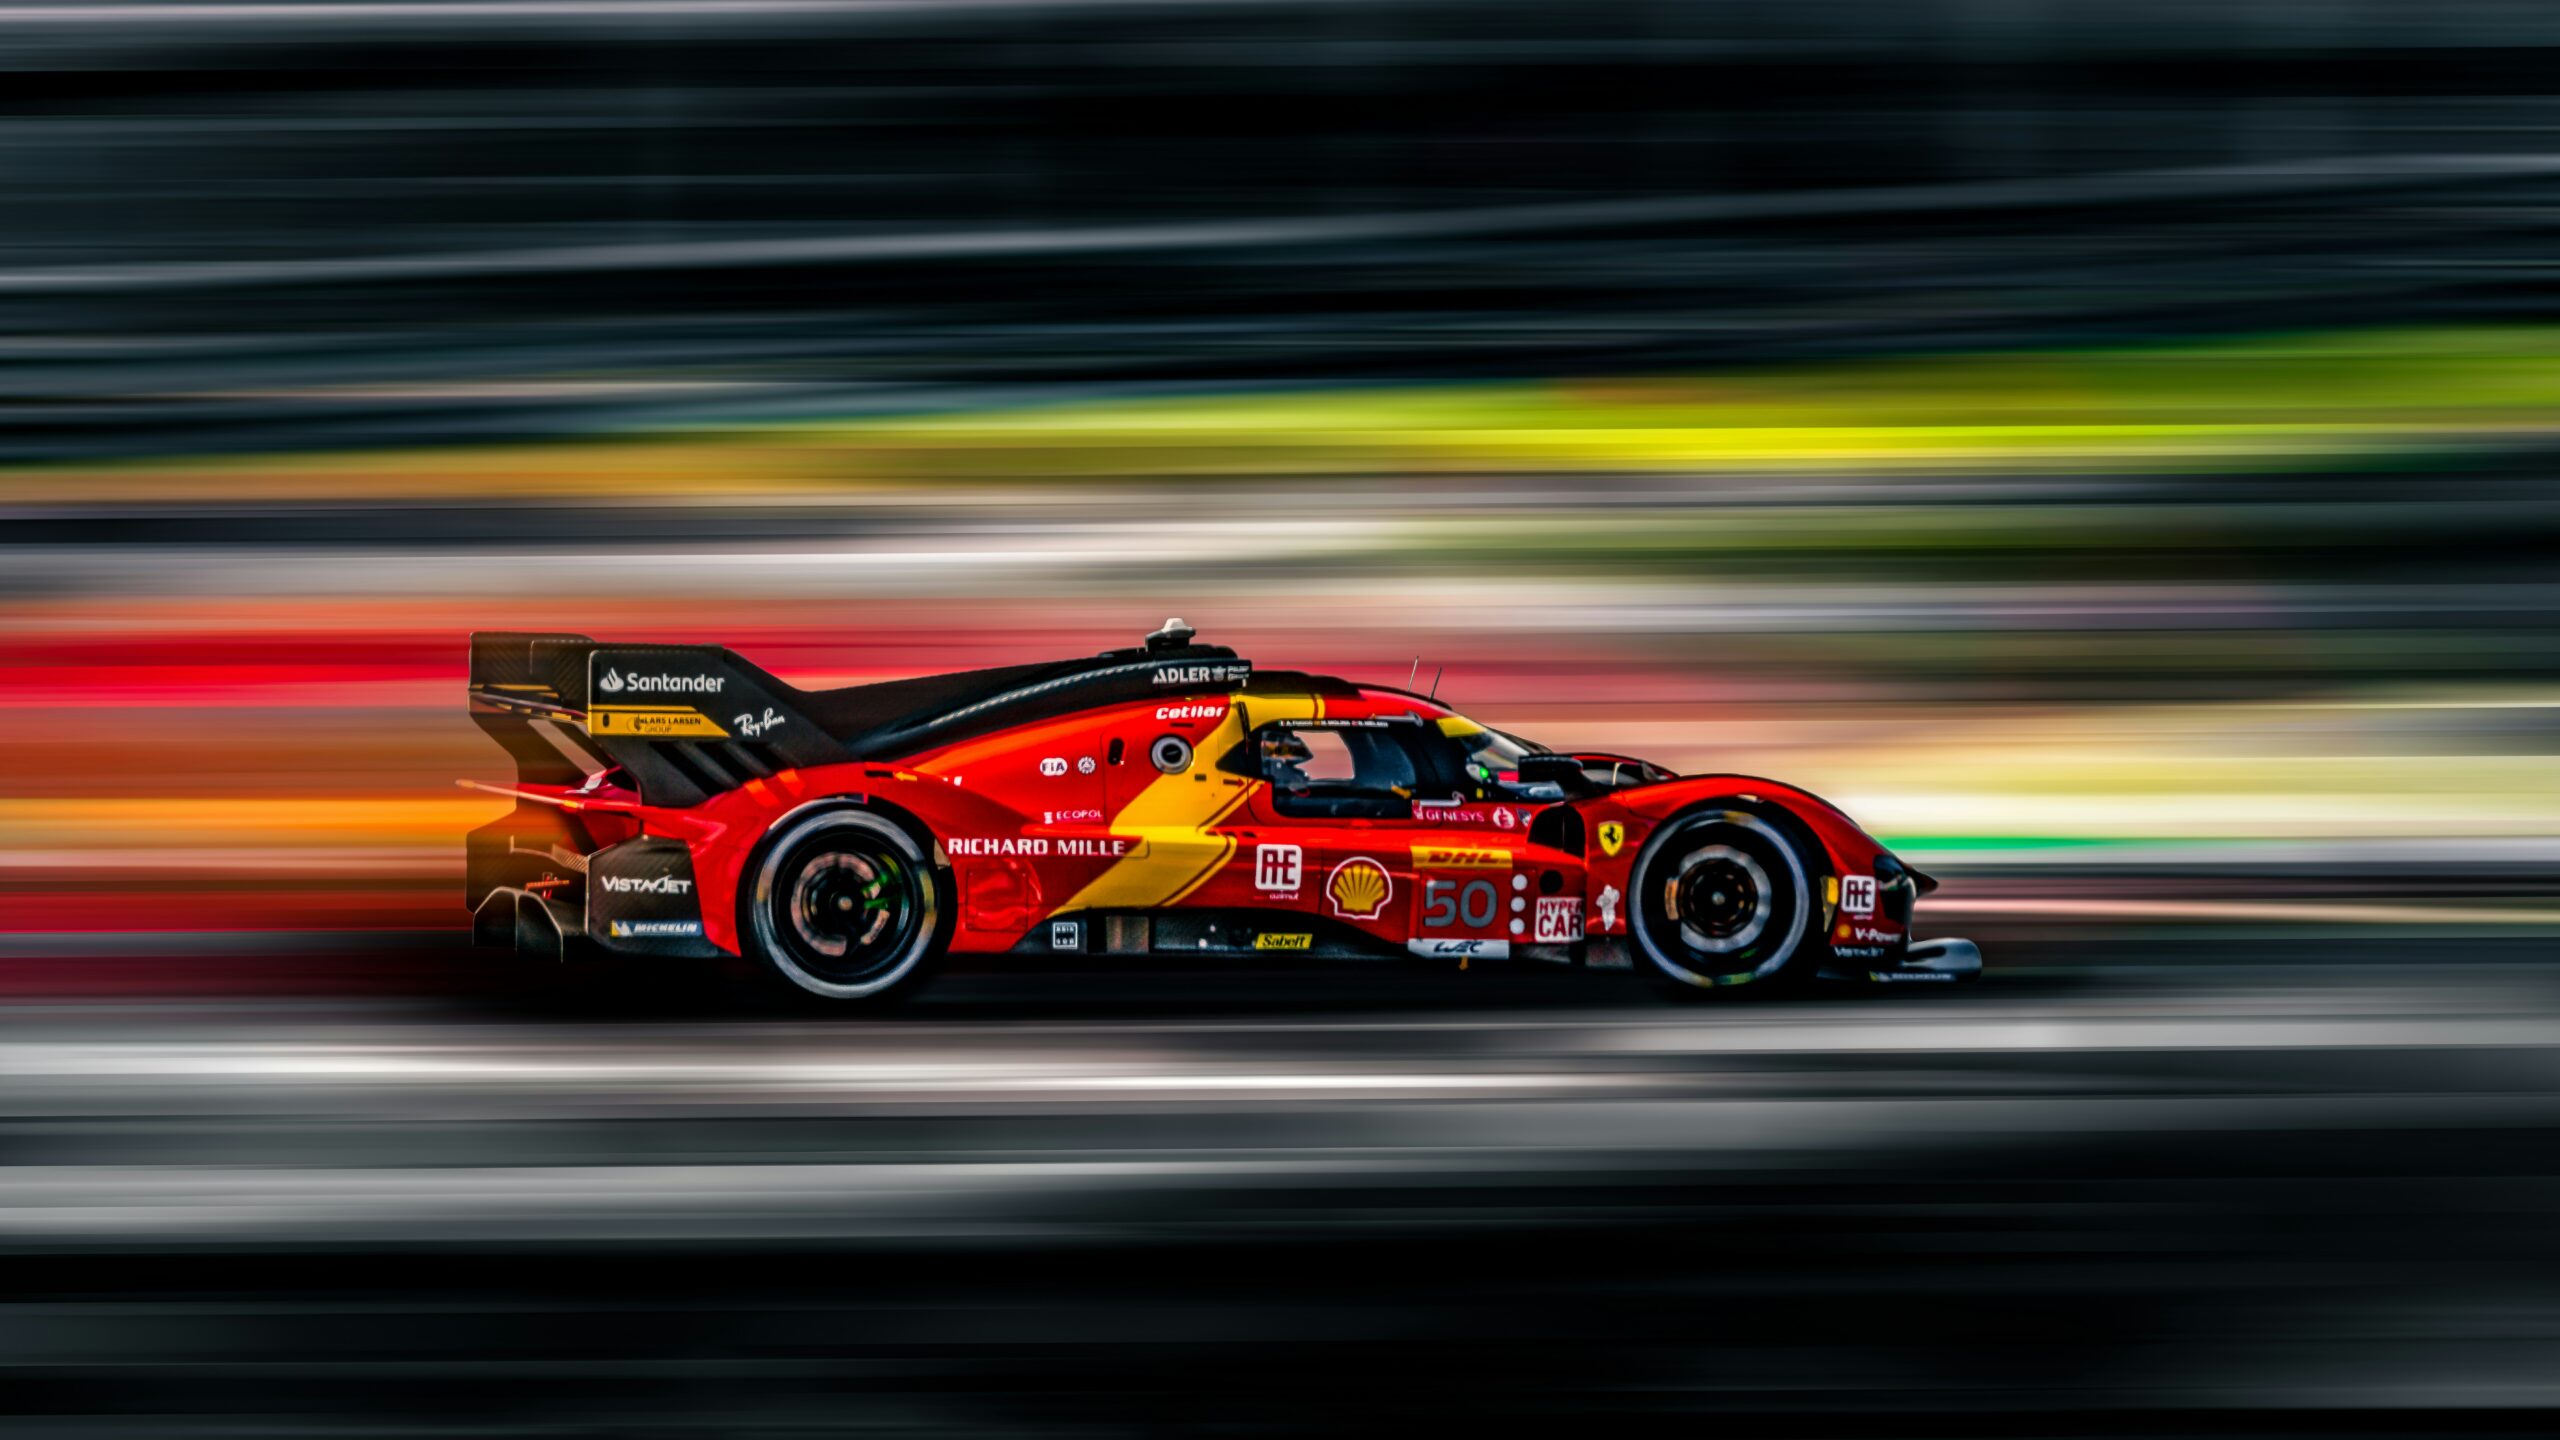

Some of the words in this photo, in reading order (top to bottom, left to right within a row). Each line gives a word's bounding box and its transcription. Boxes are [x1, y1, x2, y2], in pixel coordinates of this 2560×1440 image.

[627, 672, 725, 693] Santander
[1152, 667, 1210, 684] ADLER
[668, 716, 701, 726] LARSEN
[1042, 762, 1065, 772] FIA
[1056, 809, 1102, 820] ECOPOL
[1426, 809, 1485, 822] GENESYS
[948, 838, 1048, 855] RICHARD
[1057, 839, 1125, 856] MILLE
[1427, 850, 1499, 864] DHL
[1424, 879, 1497, 928] 50
[1539, 901, 1582, 915] HYPER
[634, 922, 698, 934] MICHELIN
[1538, 915, 1582, 937] CAR
[1263, 934, 1306, 947] Sabelt
